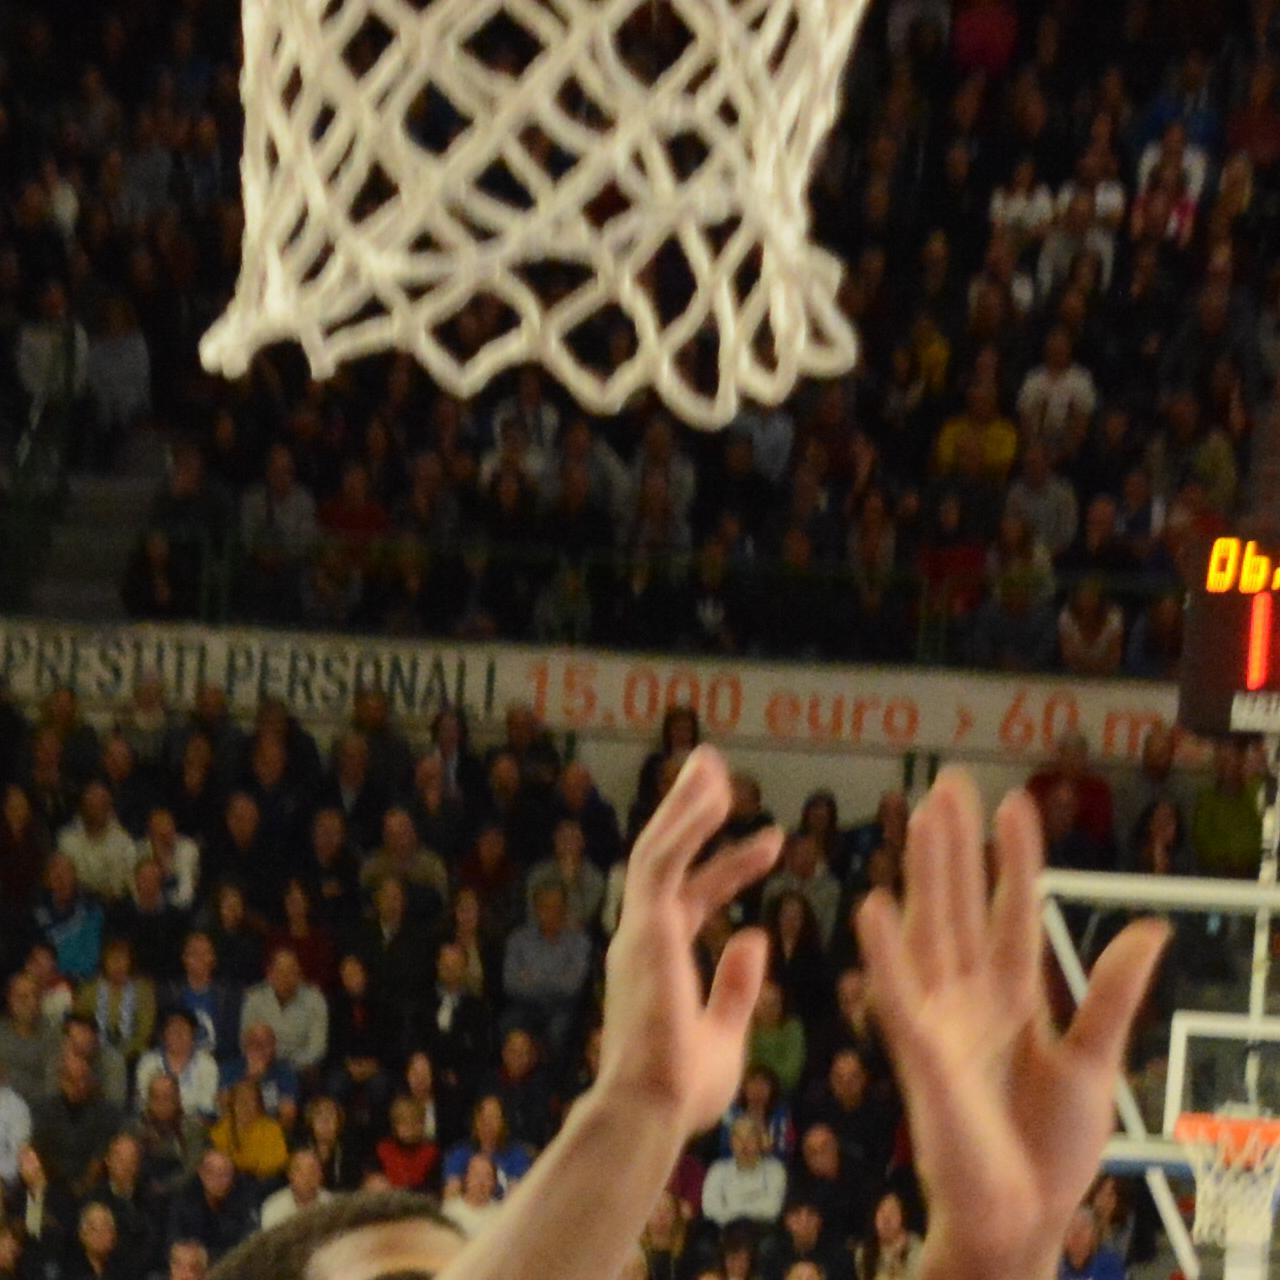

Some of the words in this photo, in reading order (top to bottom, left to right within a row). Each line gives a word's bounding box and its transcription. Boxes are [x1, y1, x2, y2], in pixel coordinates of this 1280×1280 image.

[227, 642, 495, 713] PERSONALI
[528, 658, 744, 734] 15.000
[764, 690, 920, 745] euro
[998, 686, 1079, 753] 60
